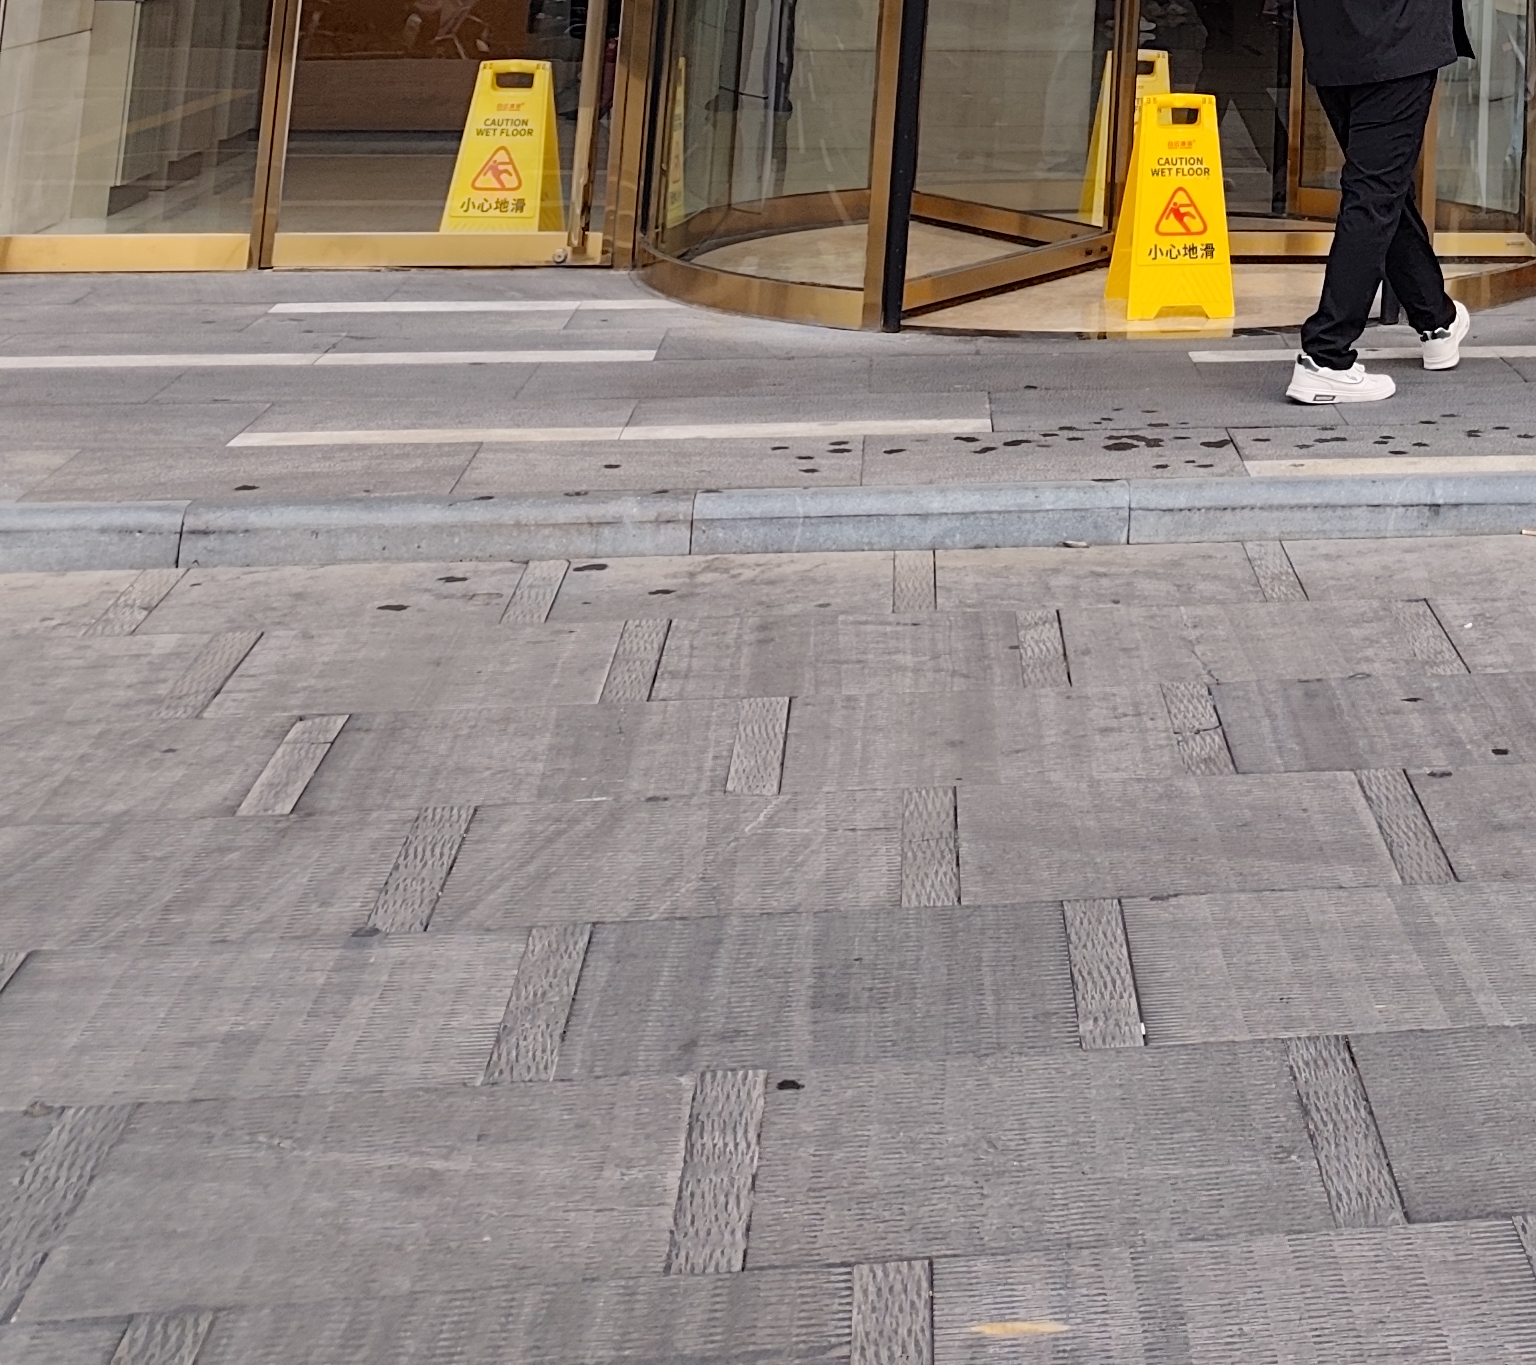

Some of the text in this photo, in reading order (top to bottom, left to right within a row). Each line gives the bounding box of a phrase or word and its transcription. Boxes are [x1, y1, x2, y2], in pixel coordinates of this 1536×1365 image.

[483, 118, 529, 127] CAUTION
[476, 128, 534, 137] WET FLOOR
[1157, 157, 1204, 166] CAUTION
[1150, 168, 1211, 177] WET FLOOR
[460, 197, 526, 214] 小心地滑
[1148, 243, 1215, 260] 小心地滑
